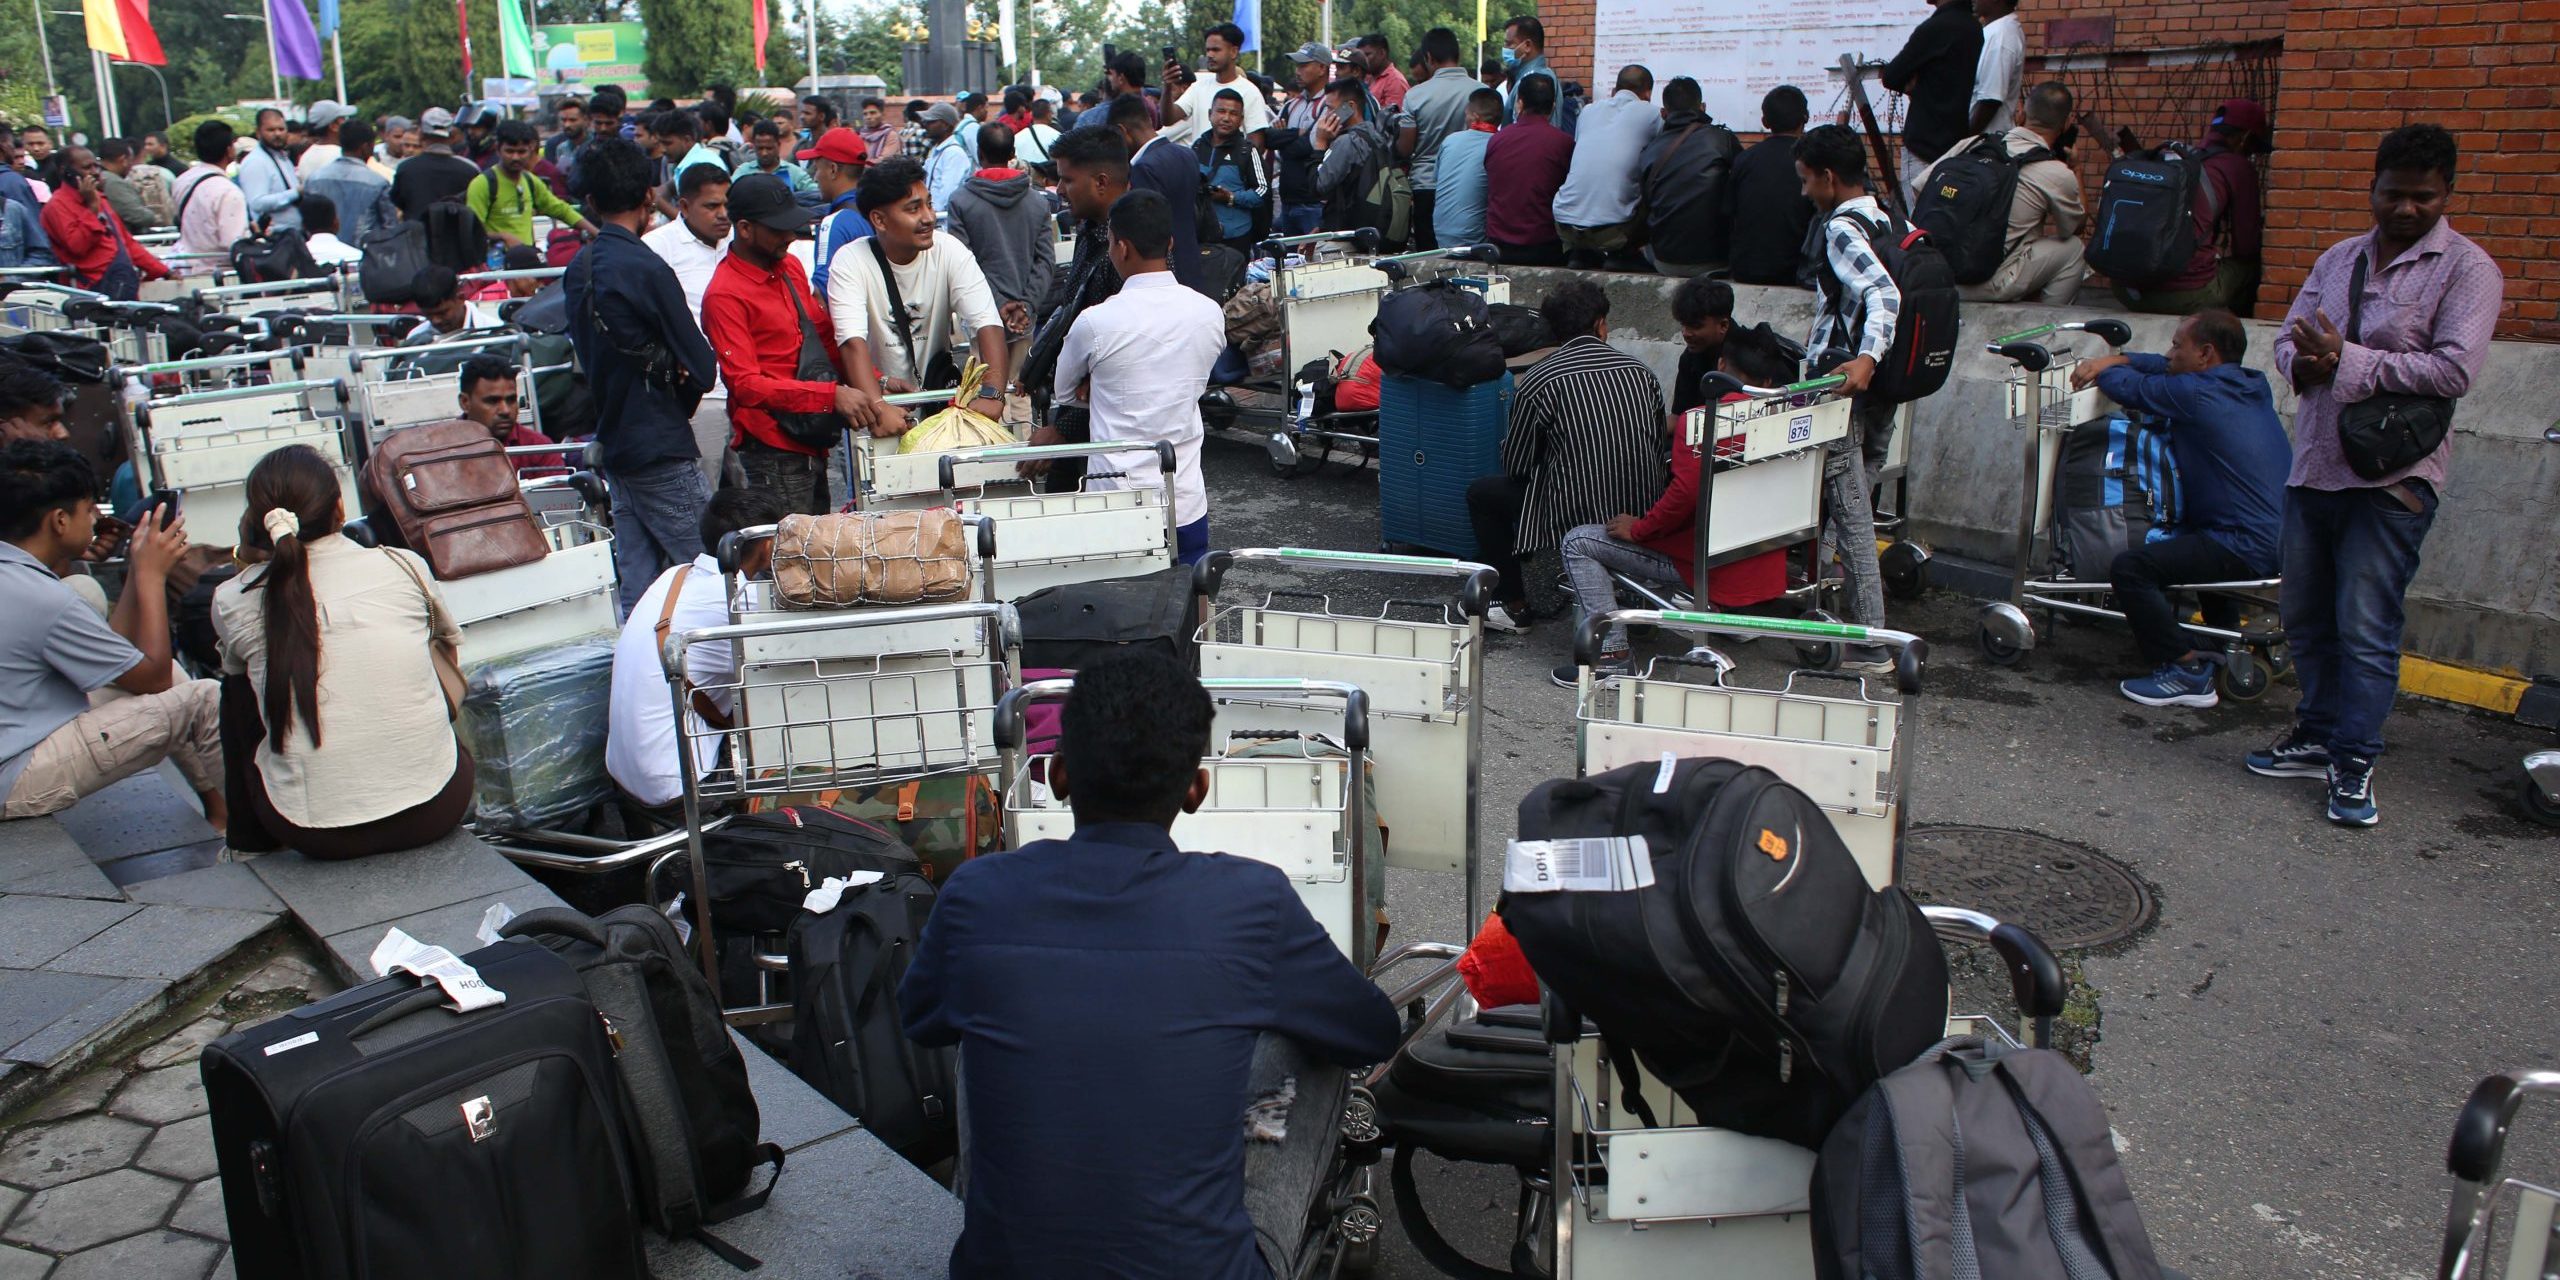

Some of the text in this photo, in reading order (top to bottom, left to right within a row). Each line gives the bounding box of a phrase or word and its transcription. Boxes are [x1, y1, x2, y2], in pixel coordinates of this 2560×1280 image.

[1791, 426, 1809, 439] 876
[1536, 851, 1548, 882] DOH
[460, 979, 485, 990] DOH
